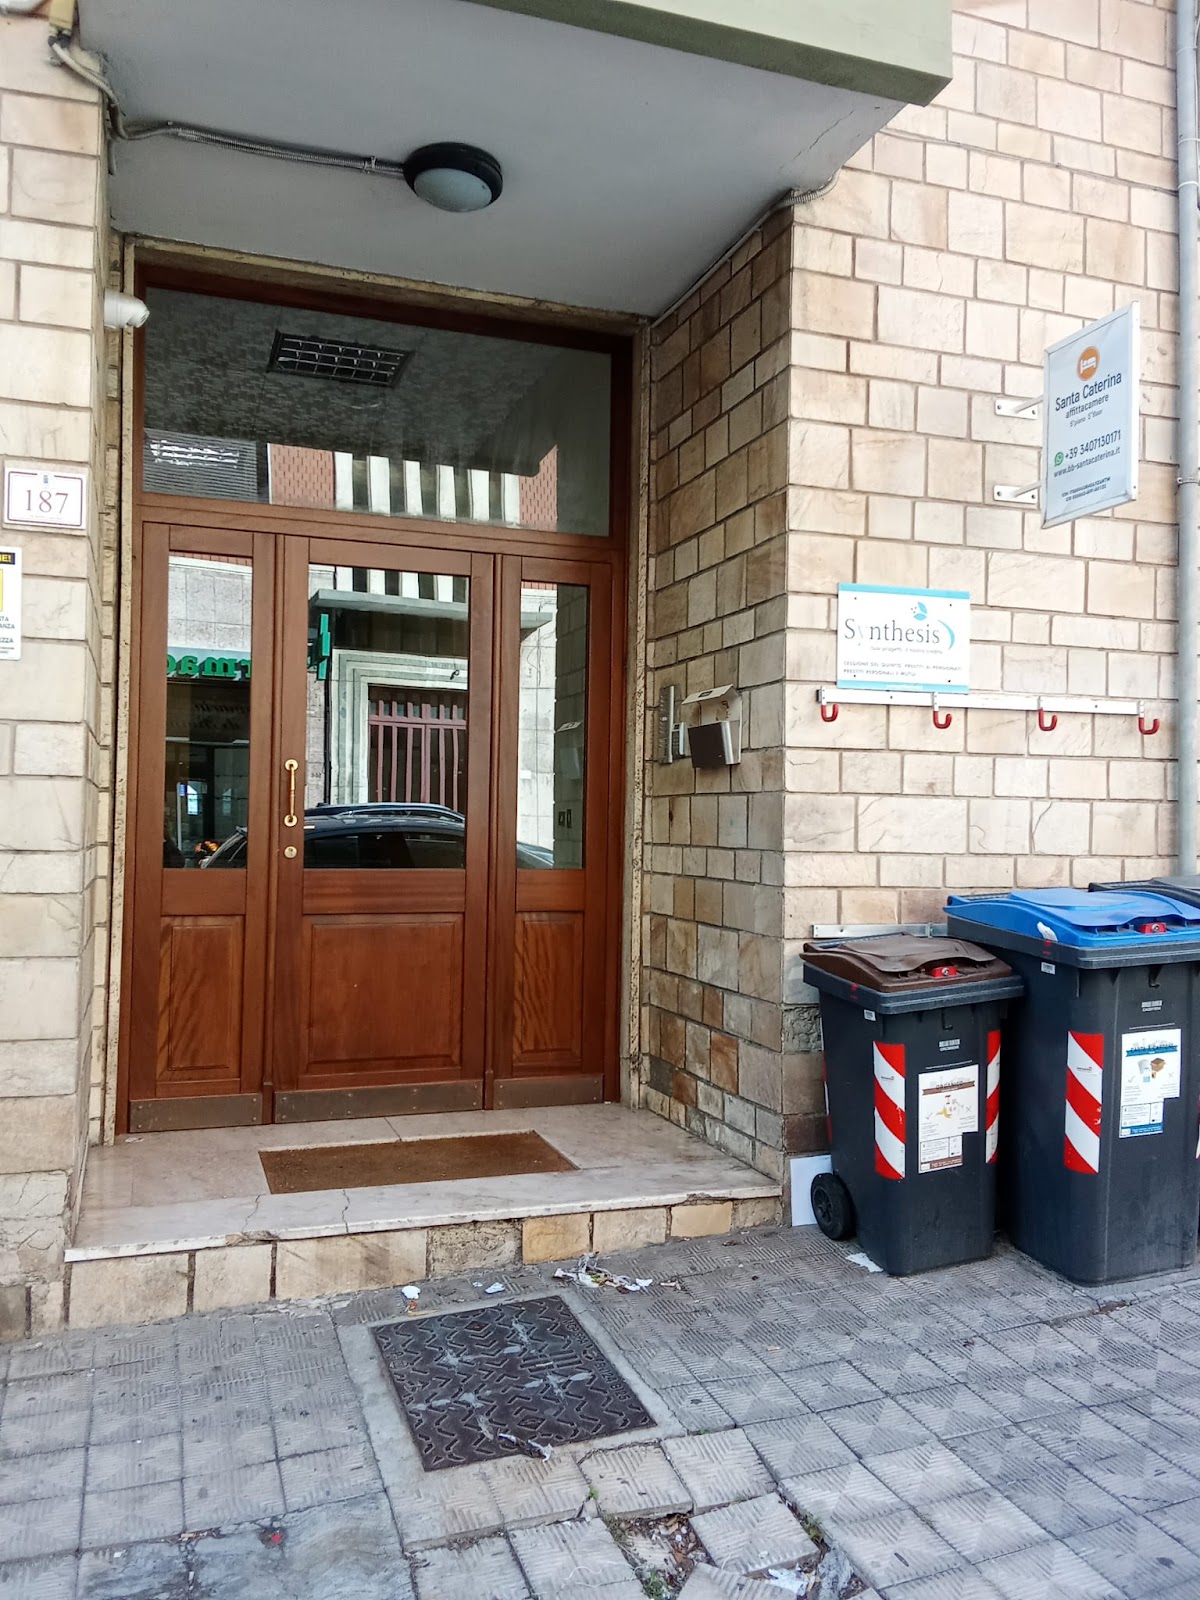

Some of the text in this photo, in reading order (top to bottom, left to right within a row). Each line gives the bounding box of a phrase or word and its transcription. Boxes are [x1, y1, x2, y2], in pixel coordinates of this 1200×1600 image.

[1055, 372, 1122, 411] Santa Caterina
[26, 489, 69, 515] 187
